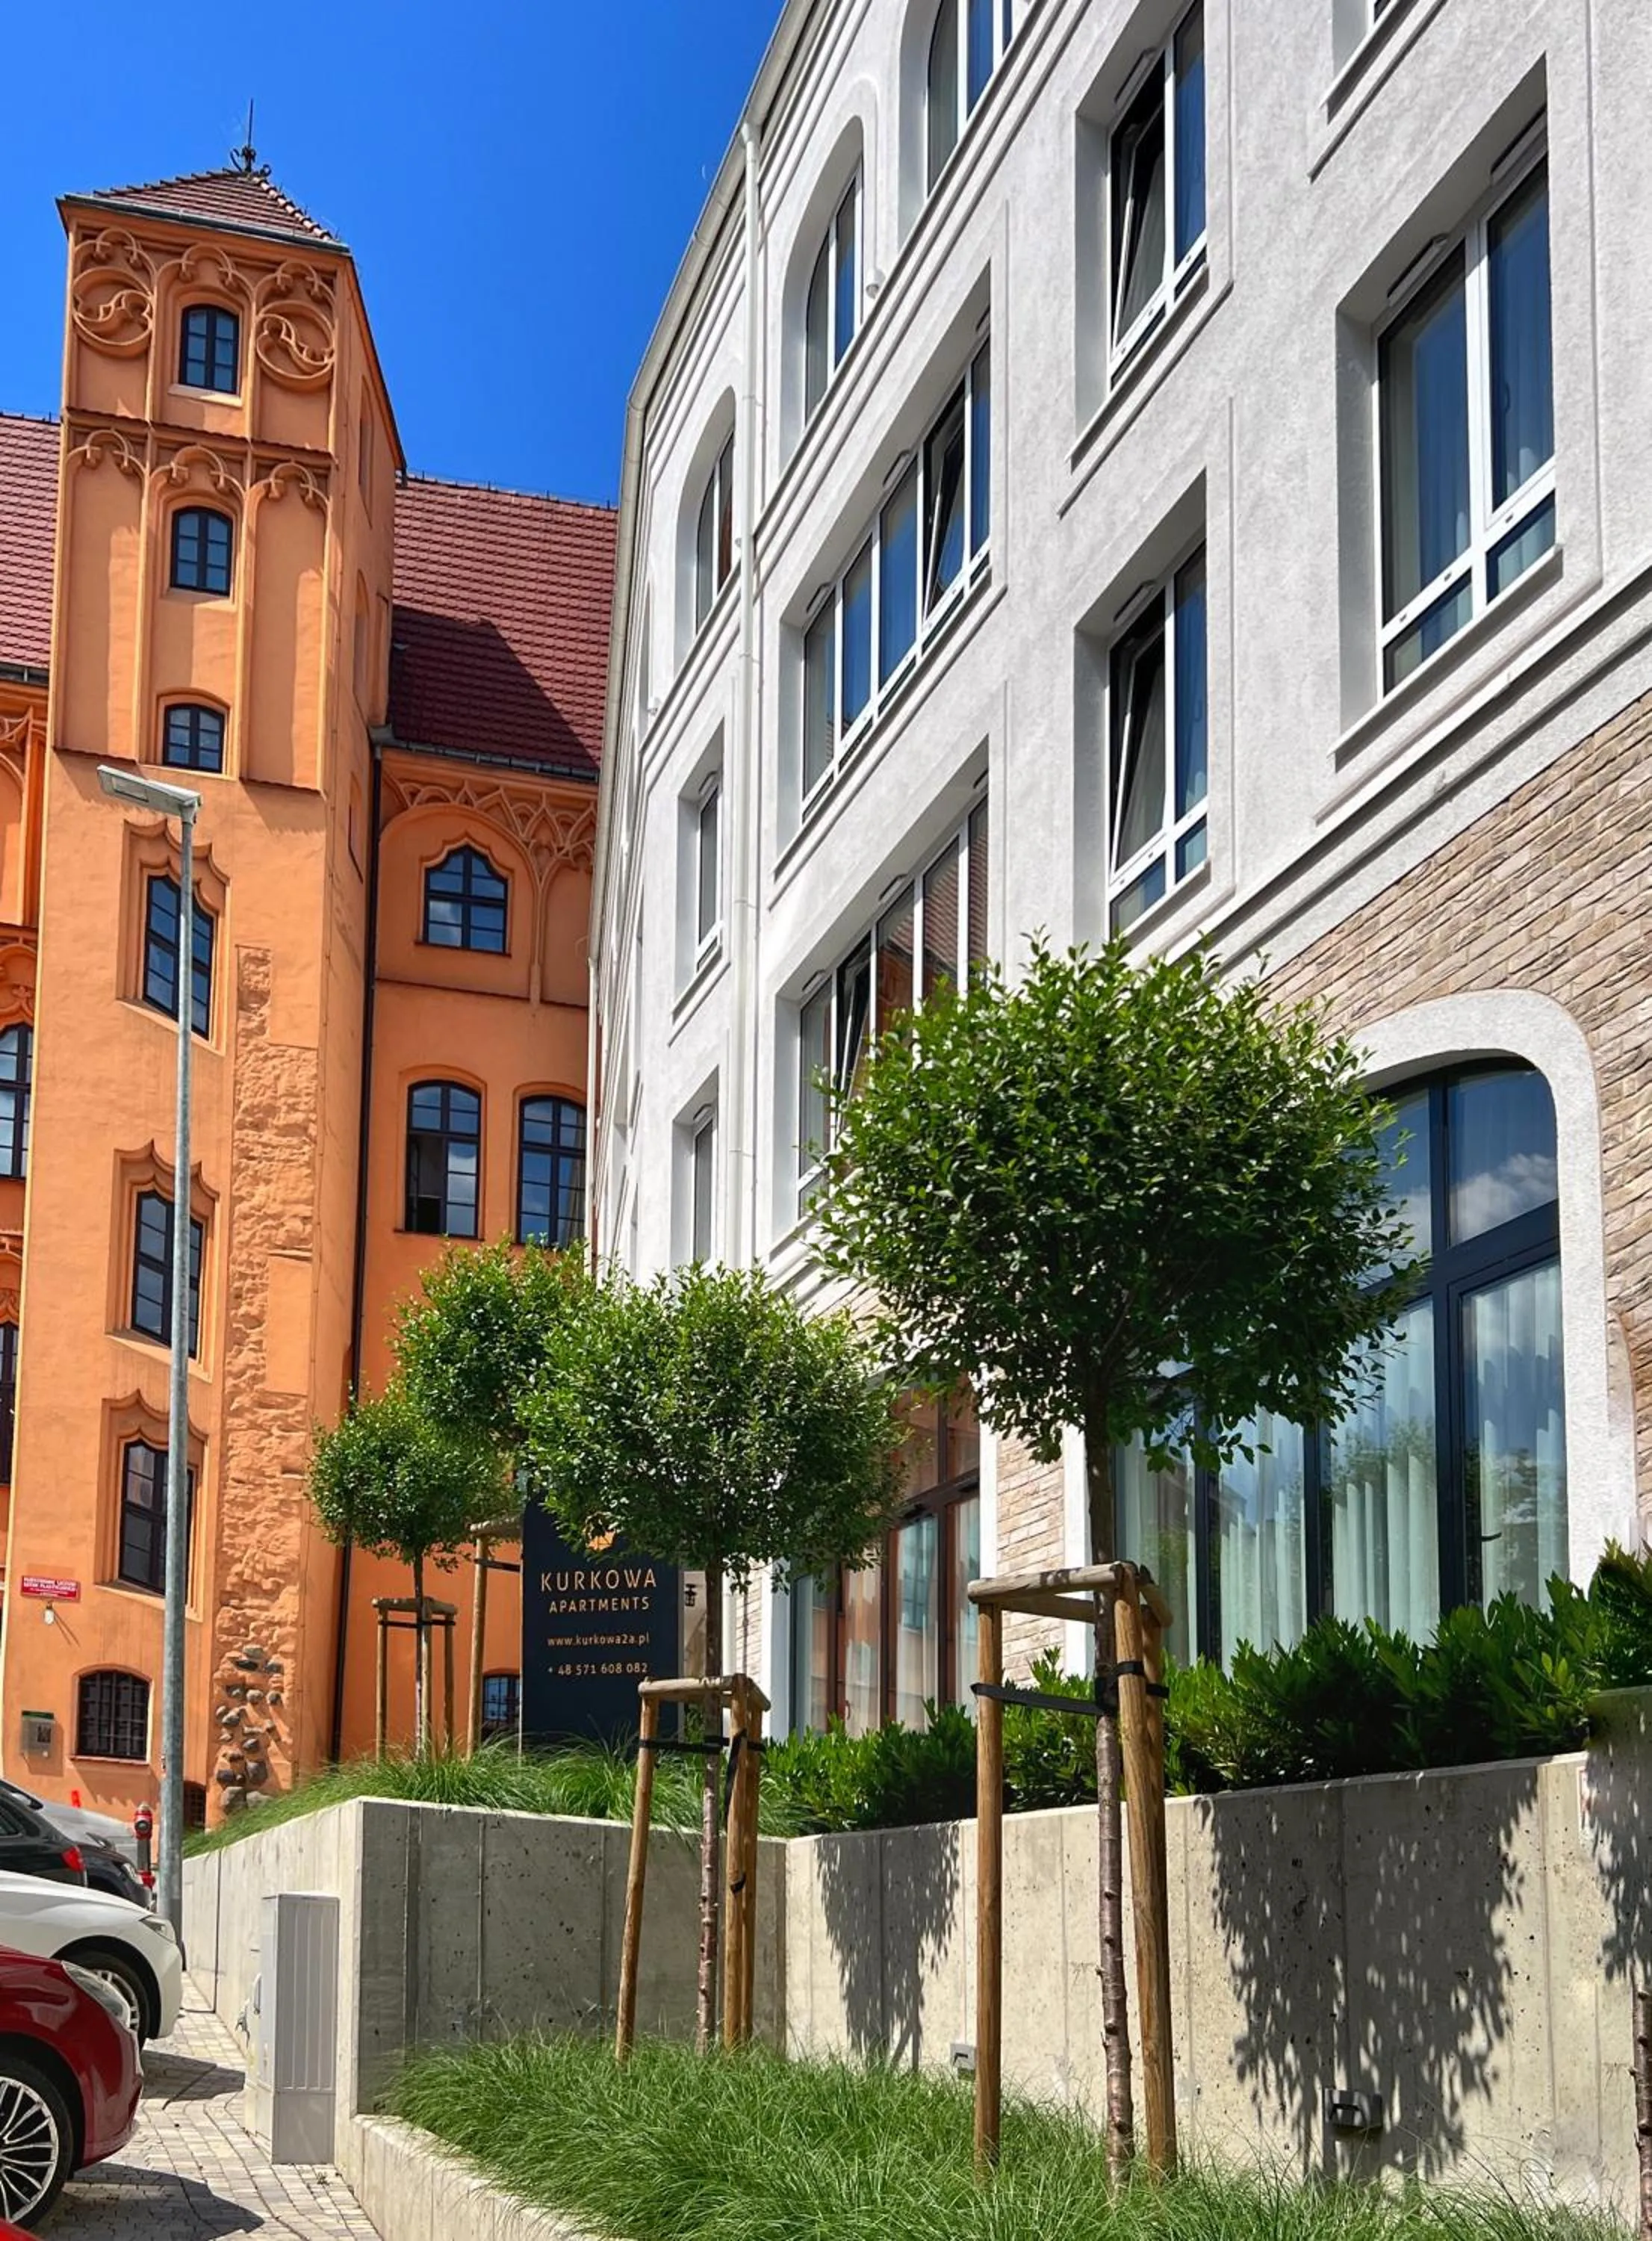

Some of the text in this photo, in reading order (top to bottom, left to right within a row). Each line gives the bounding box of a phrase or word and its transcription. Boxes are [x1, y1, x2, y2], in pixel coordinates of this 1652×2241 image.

[541, 1568, 657, 1592] KURKOWA
[549, 1596, 650, 1614] APARTMENTS
[547, 1631, 650, 1647] www.kurkowa2a.pl
[558, 1664, 572, 1676] 48
[576, 1663, 597, 1675] 571
[600, 1662, 623, 1674] 608
[626, 1661, 648, 1673] 082
